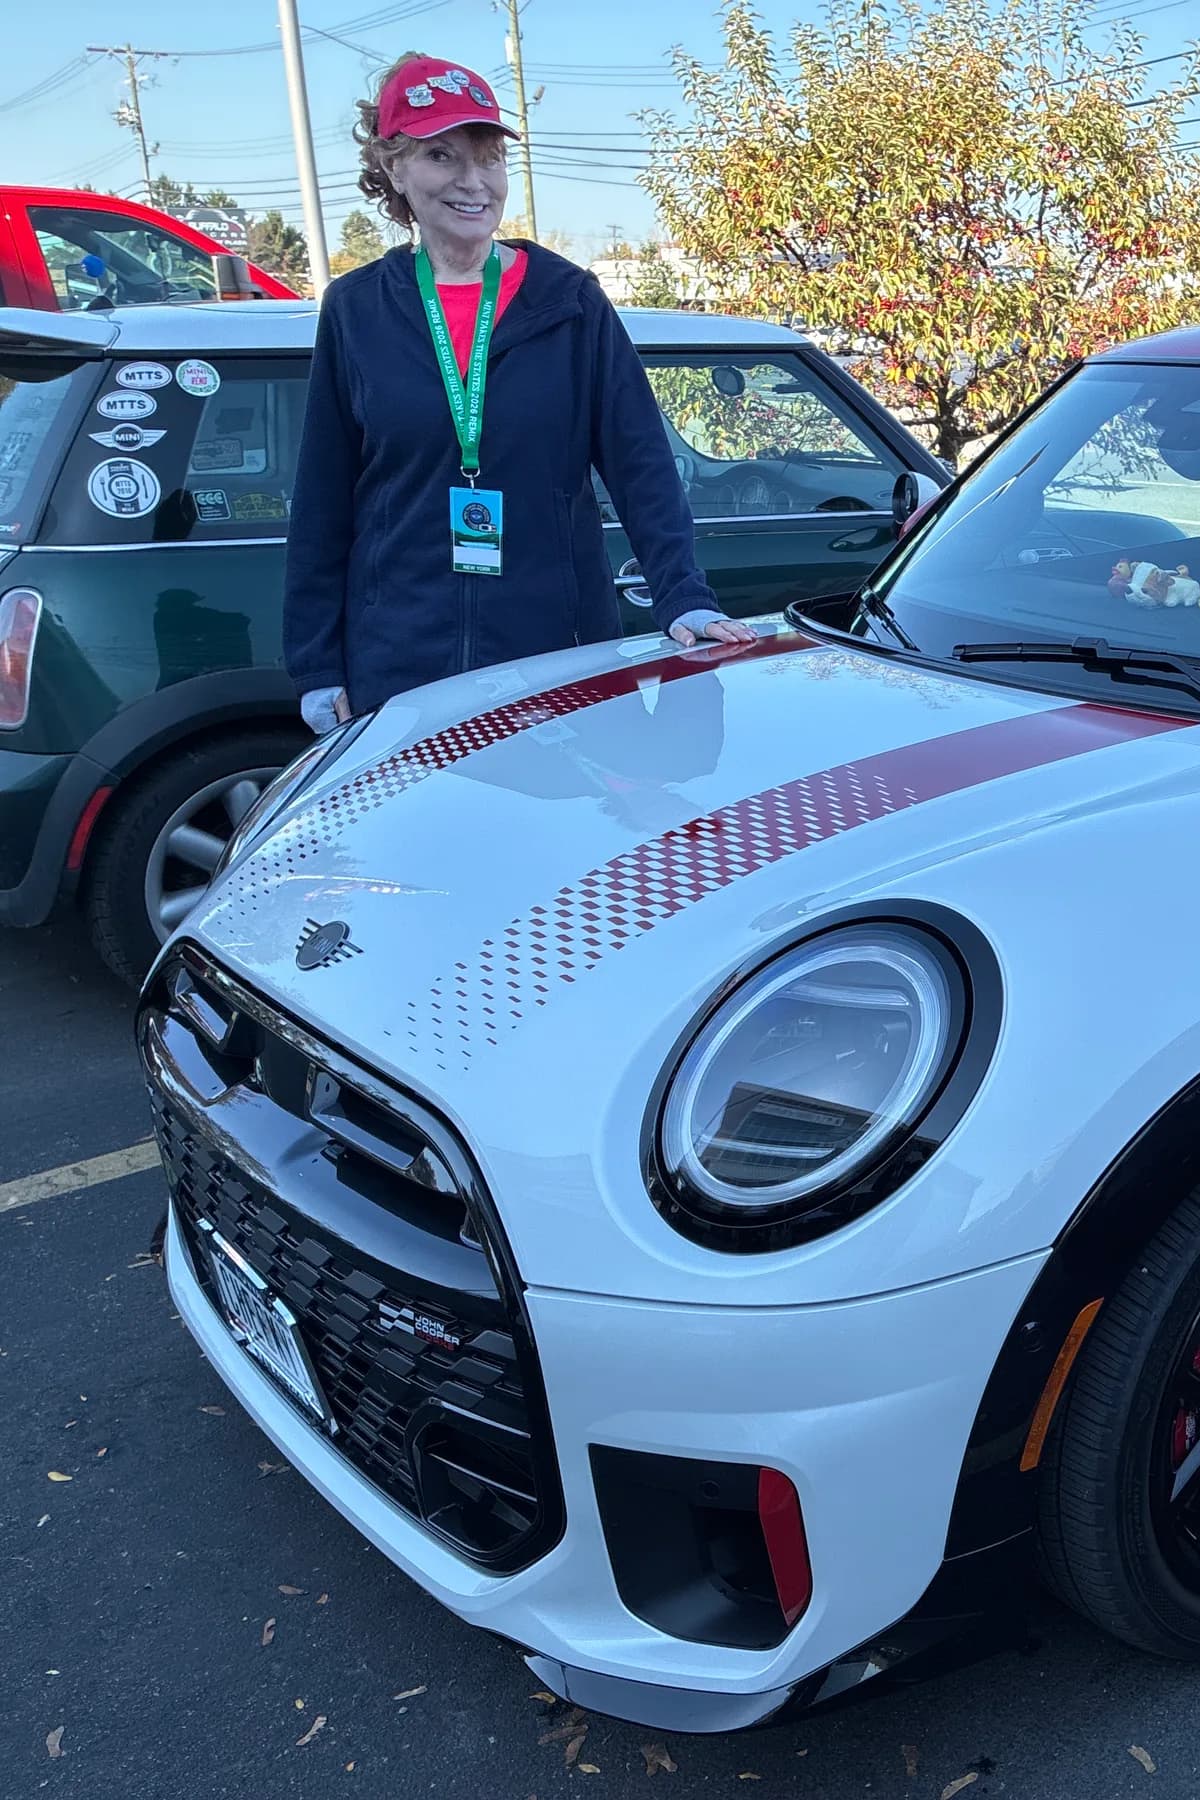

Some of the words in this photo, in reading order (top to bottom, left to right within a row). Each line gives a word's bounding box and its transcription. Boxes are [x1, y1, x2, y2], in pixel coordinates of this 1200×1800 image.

[427, 298, 439, 324] REMIX
[435, 325, 447, 345] 2026
[477, 319, 489, 343] TAKES
[440, 346, 455, 374] STATES
[474, 343, 484, 360] THE
[125, 371, 163, 380] MTTS
[448, 375, 458, 393] THE
[471, 361, 482, 392] STATES
[106, 400, 146, 410] MTTS
[469, 393, 480, 414] 2026
[115, 433, 141, 442] MINI
[467, 416, 477, 442] REMIX
[415, 1316, 444, 1331] JOHN
[415, 1322, 459, 1346] COOPER
[416, 1331, 455, 1351] WORKS
